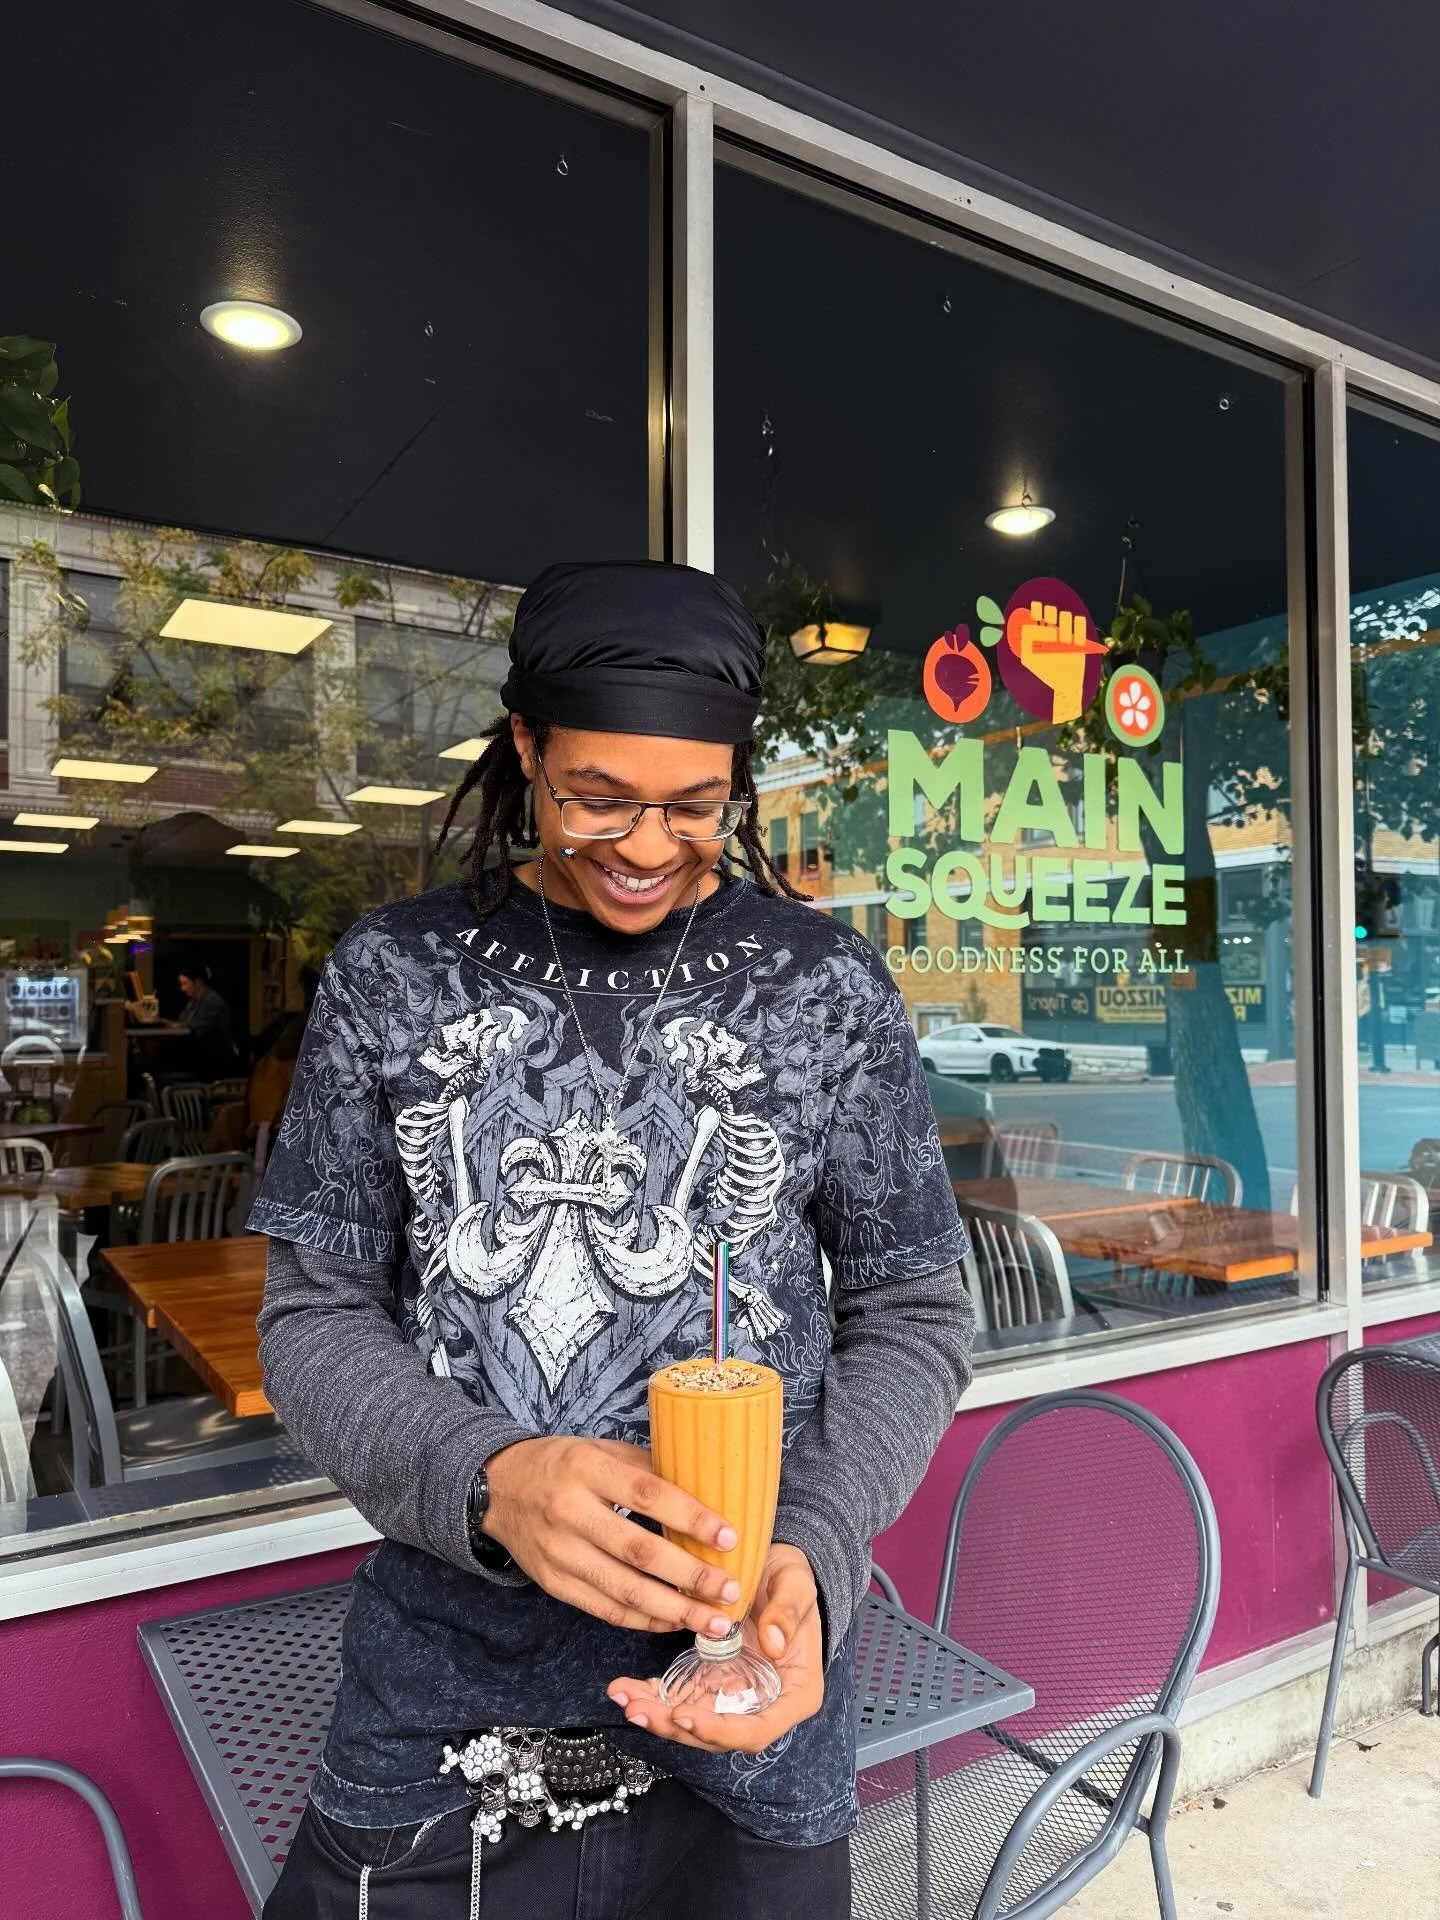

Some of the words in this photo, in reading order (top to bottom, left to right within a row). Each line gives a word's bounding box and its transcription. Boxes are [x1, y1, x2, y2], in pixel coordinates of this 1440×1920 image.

[887, 729, 1184, 855] MAIN
[885, 848, 1187, 930] SQUEEZE
[456, 927, 764, 989] AFFLICTION
[886, 945, 1064, 974] GOODNESS
[1073, 947, 1129, 975] FOR
[1137, 948, 1189, 975] ALL
